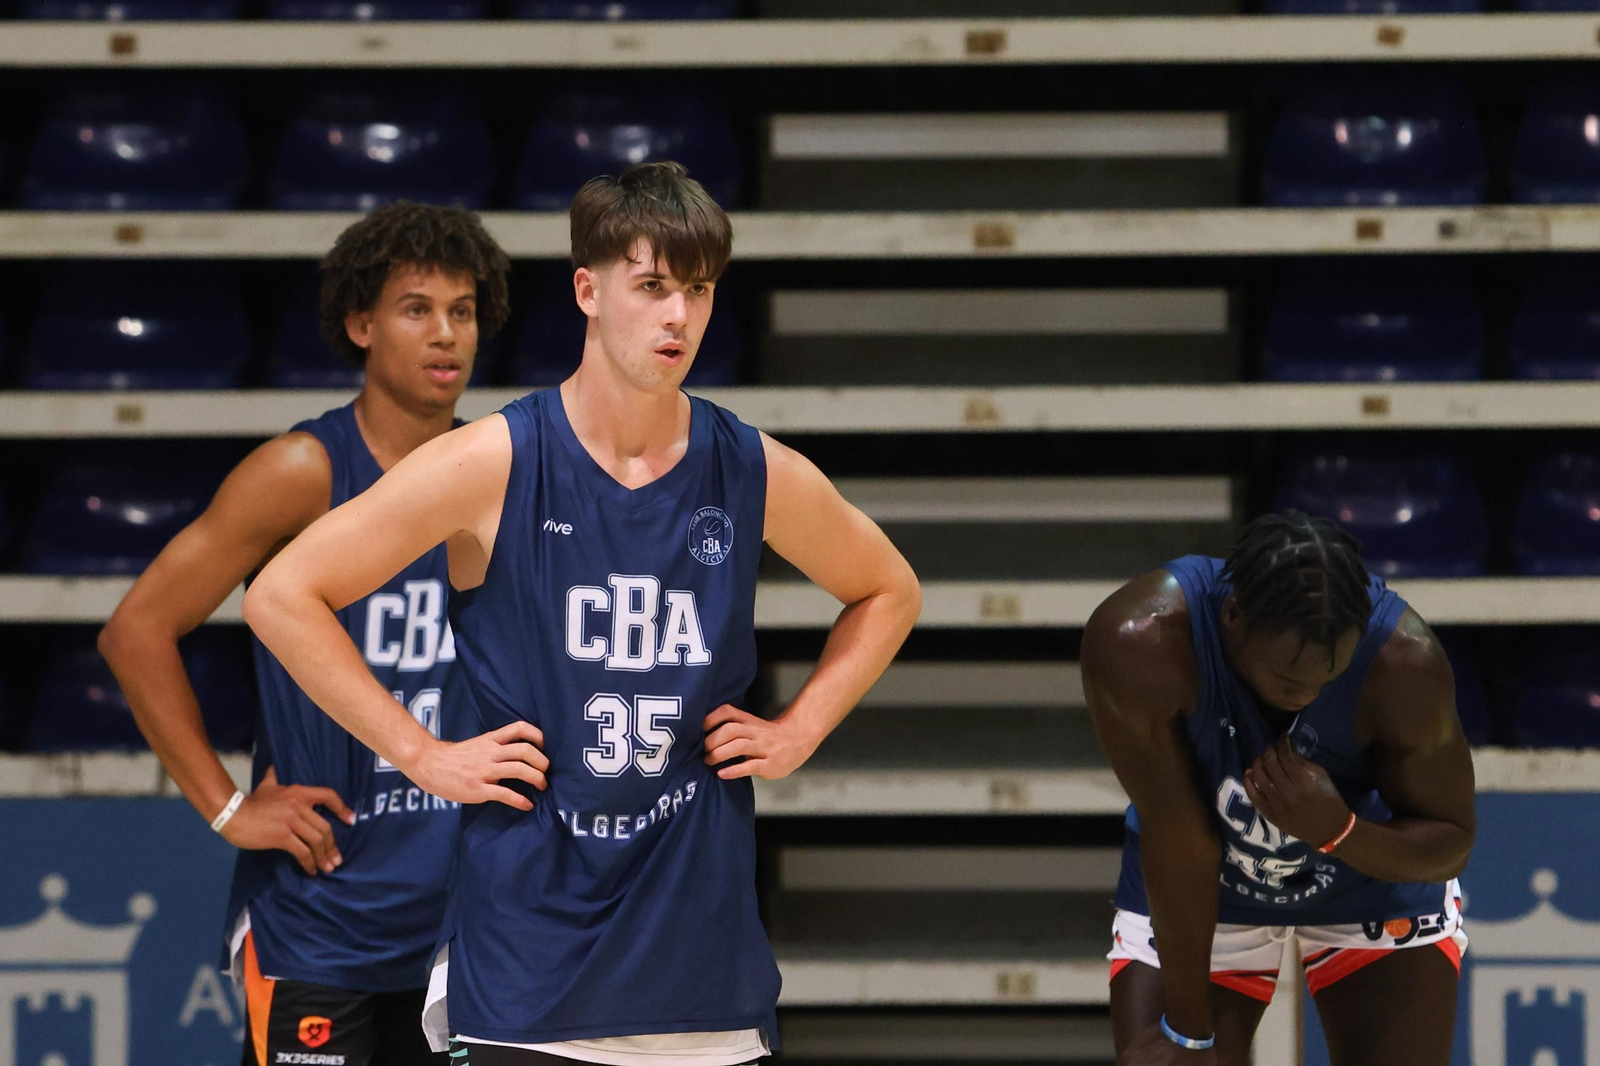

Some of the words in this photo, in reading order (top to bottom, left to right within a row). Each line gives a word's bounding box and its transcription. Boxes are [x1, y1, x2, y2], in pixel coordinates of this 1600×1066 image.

[702, 537, 721, 555] CBA
[566, 573, 712, 672] CBA
[582, 692, 683, 778] 35
[1220, 863, 1337, 904] LGECIRAS
